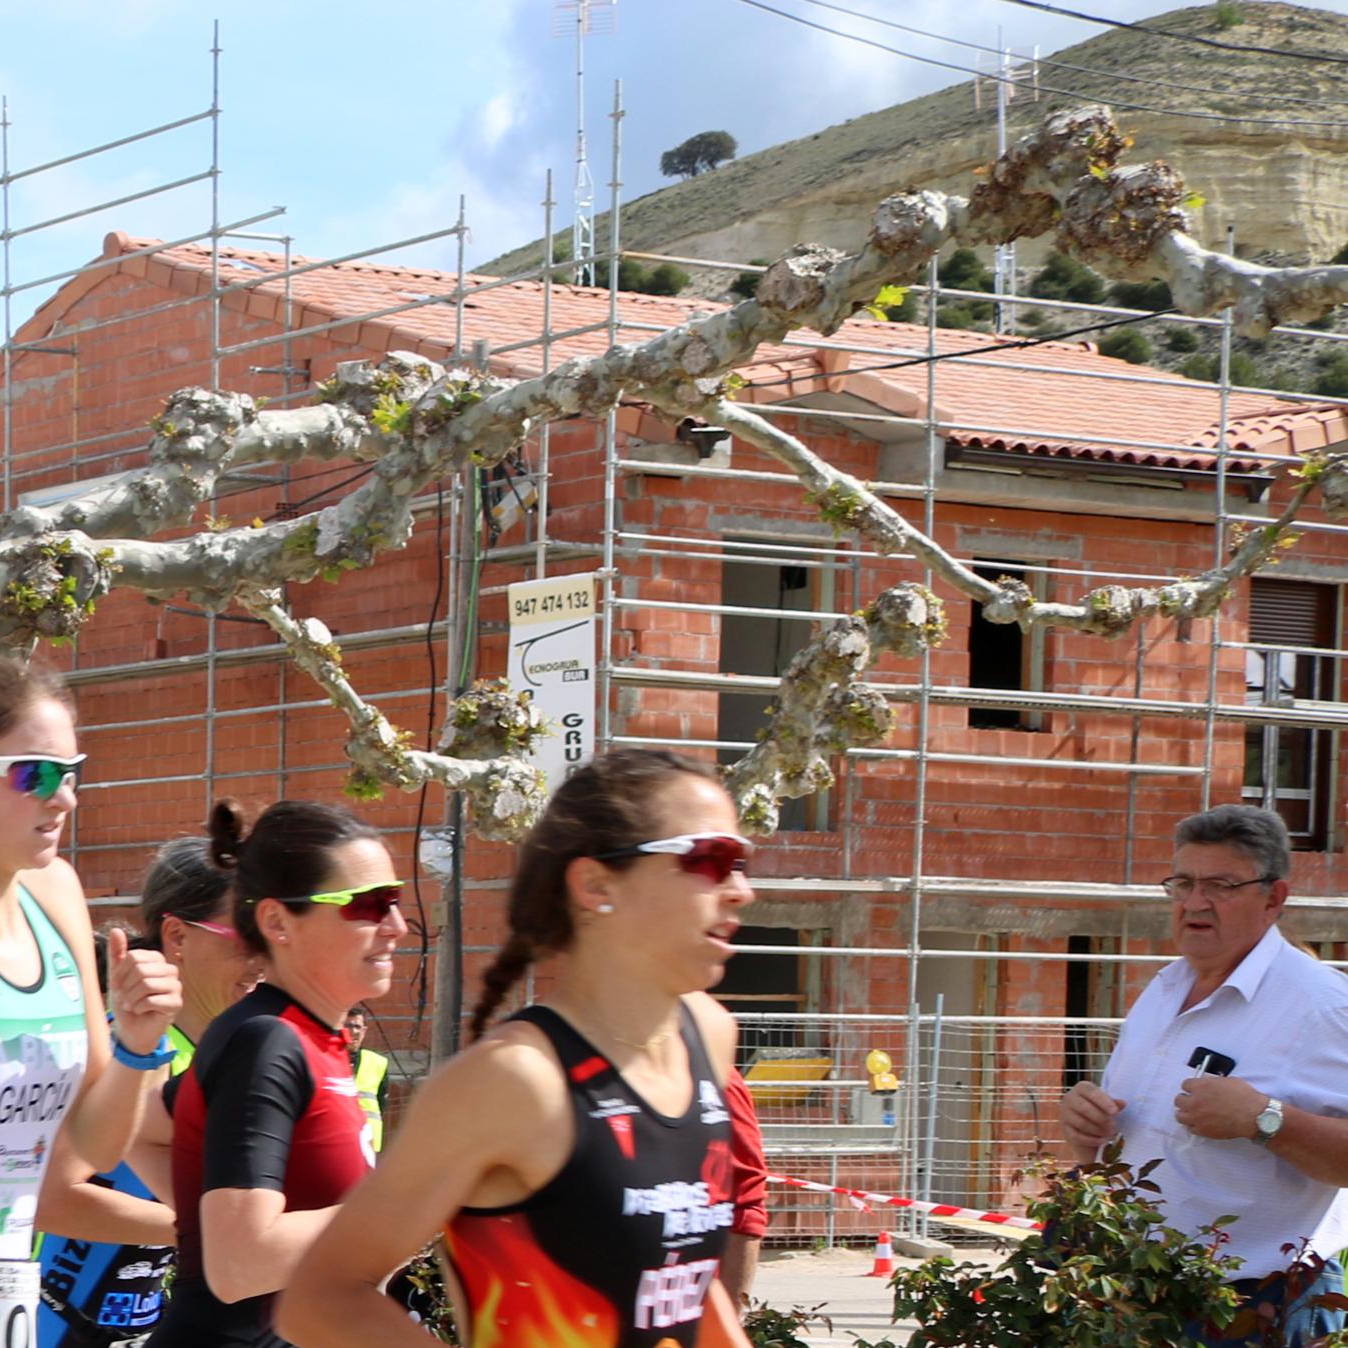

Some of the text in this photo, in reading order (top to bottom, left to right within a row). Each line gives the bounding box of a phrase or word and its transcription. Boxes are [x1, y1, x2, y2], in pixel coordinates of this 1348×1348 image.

[515, 590, 589, 617] 947 474 132
[563, 669, 587, 681] BUR
[633, 1250, 720, 1330] PÉREZ
